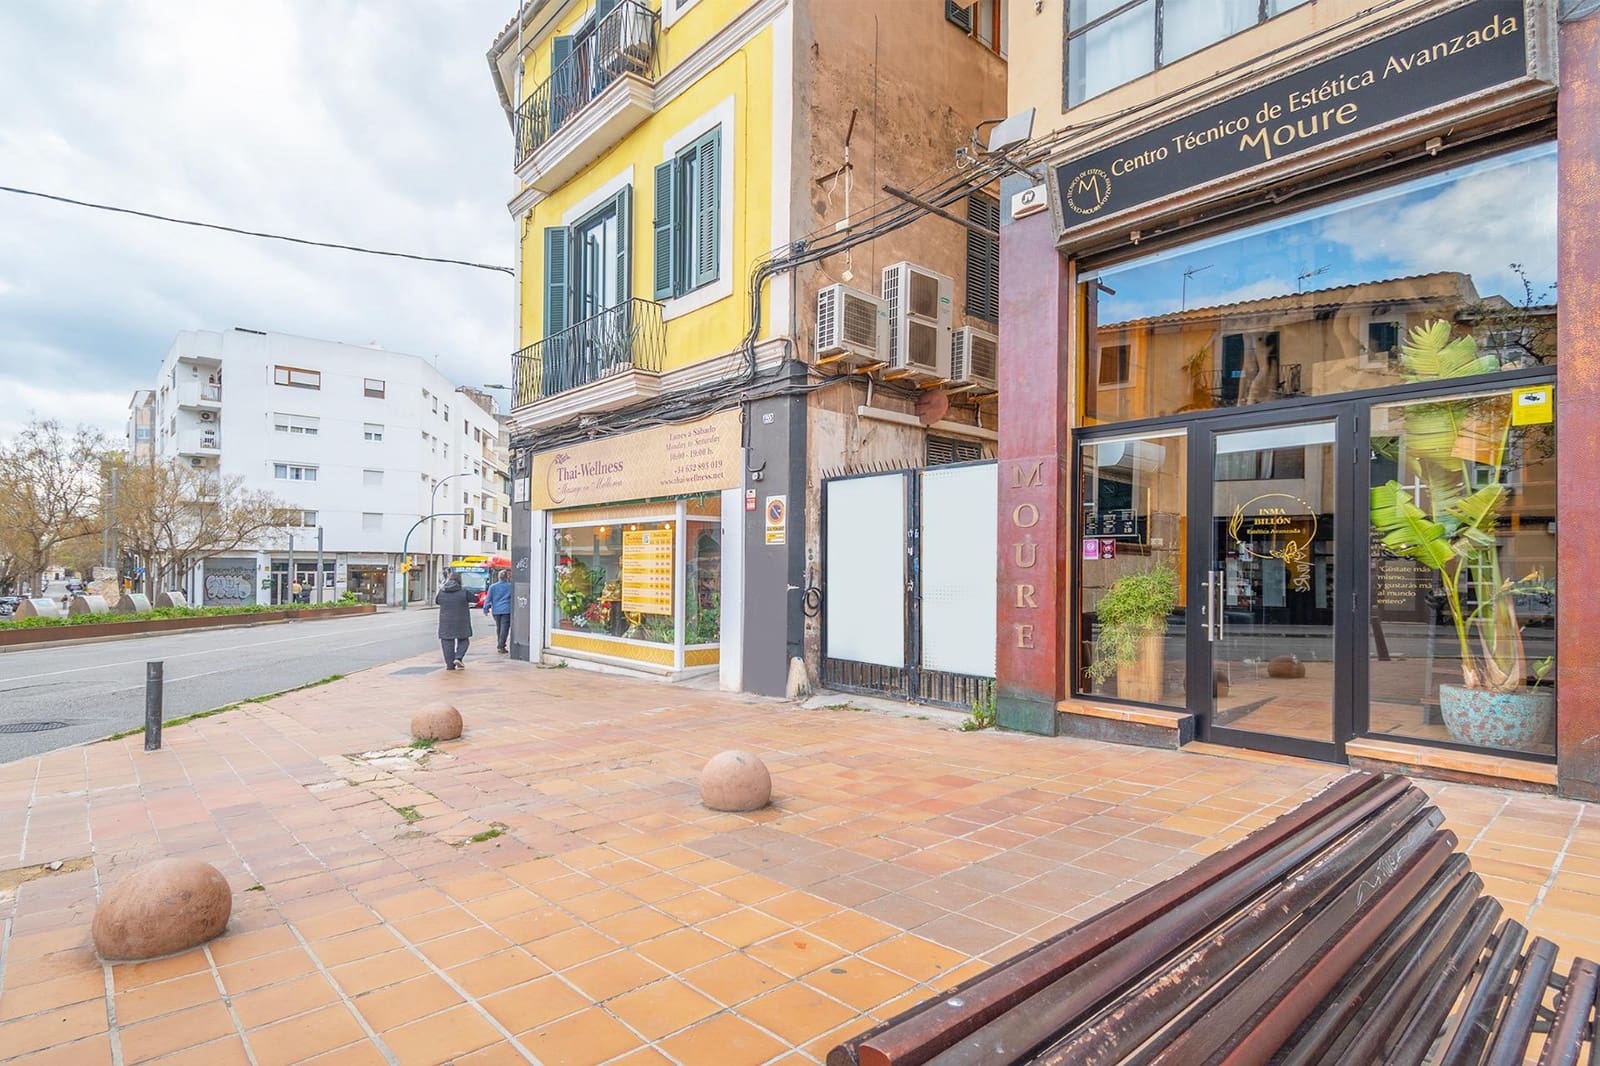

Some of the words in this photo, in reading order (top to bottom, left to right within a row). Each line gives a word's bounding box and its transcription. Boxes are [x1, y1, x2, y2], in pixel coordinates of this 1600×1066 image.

[1111, 146, 1168, 177] Centro
[1172, 116, 1250, 153] Técnico
[1255, 102, 1282, 123] de
[1289, 70, 1375, 113] Estética
[1382, 14, 1518, 79] Avanzada
[557, 460, 624, 481] Thai-Wellness
[1254, 516, 1291, 525] BILLÓN
[1010, 461, 1045, 650] MOURE
[1387, 589, 1416, 597] mundo
